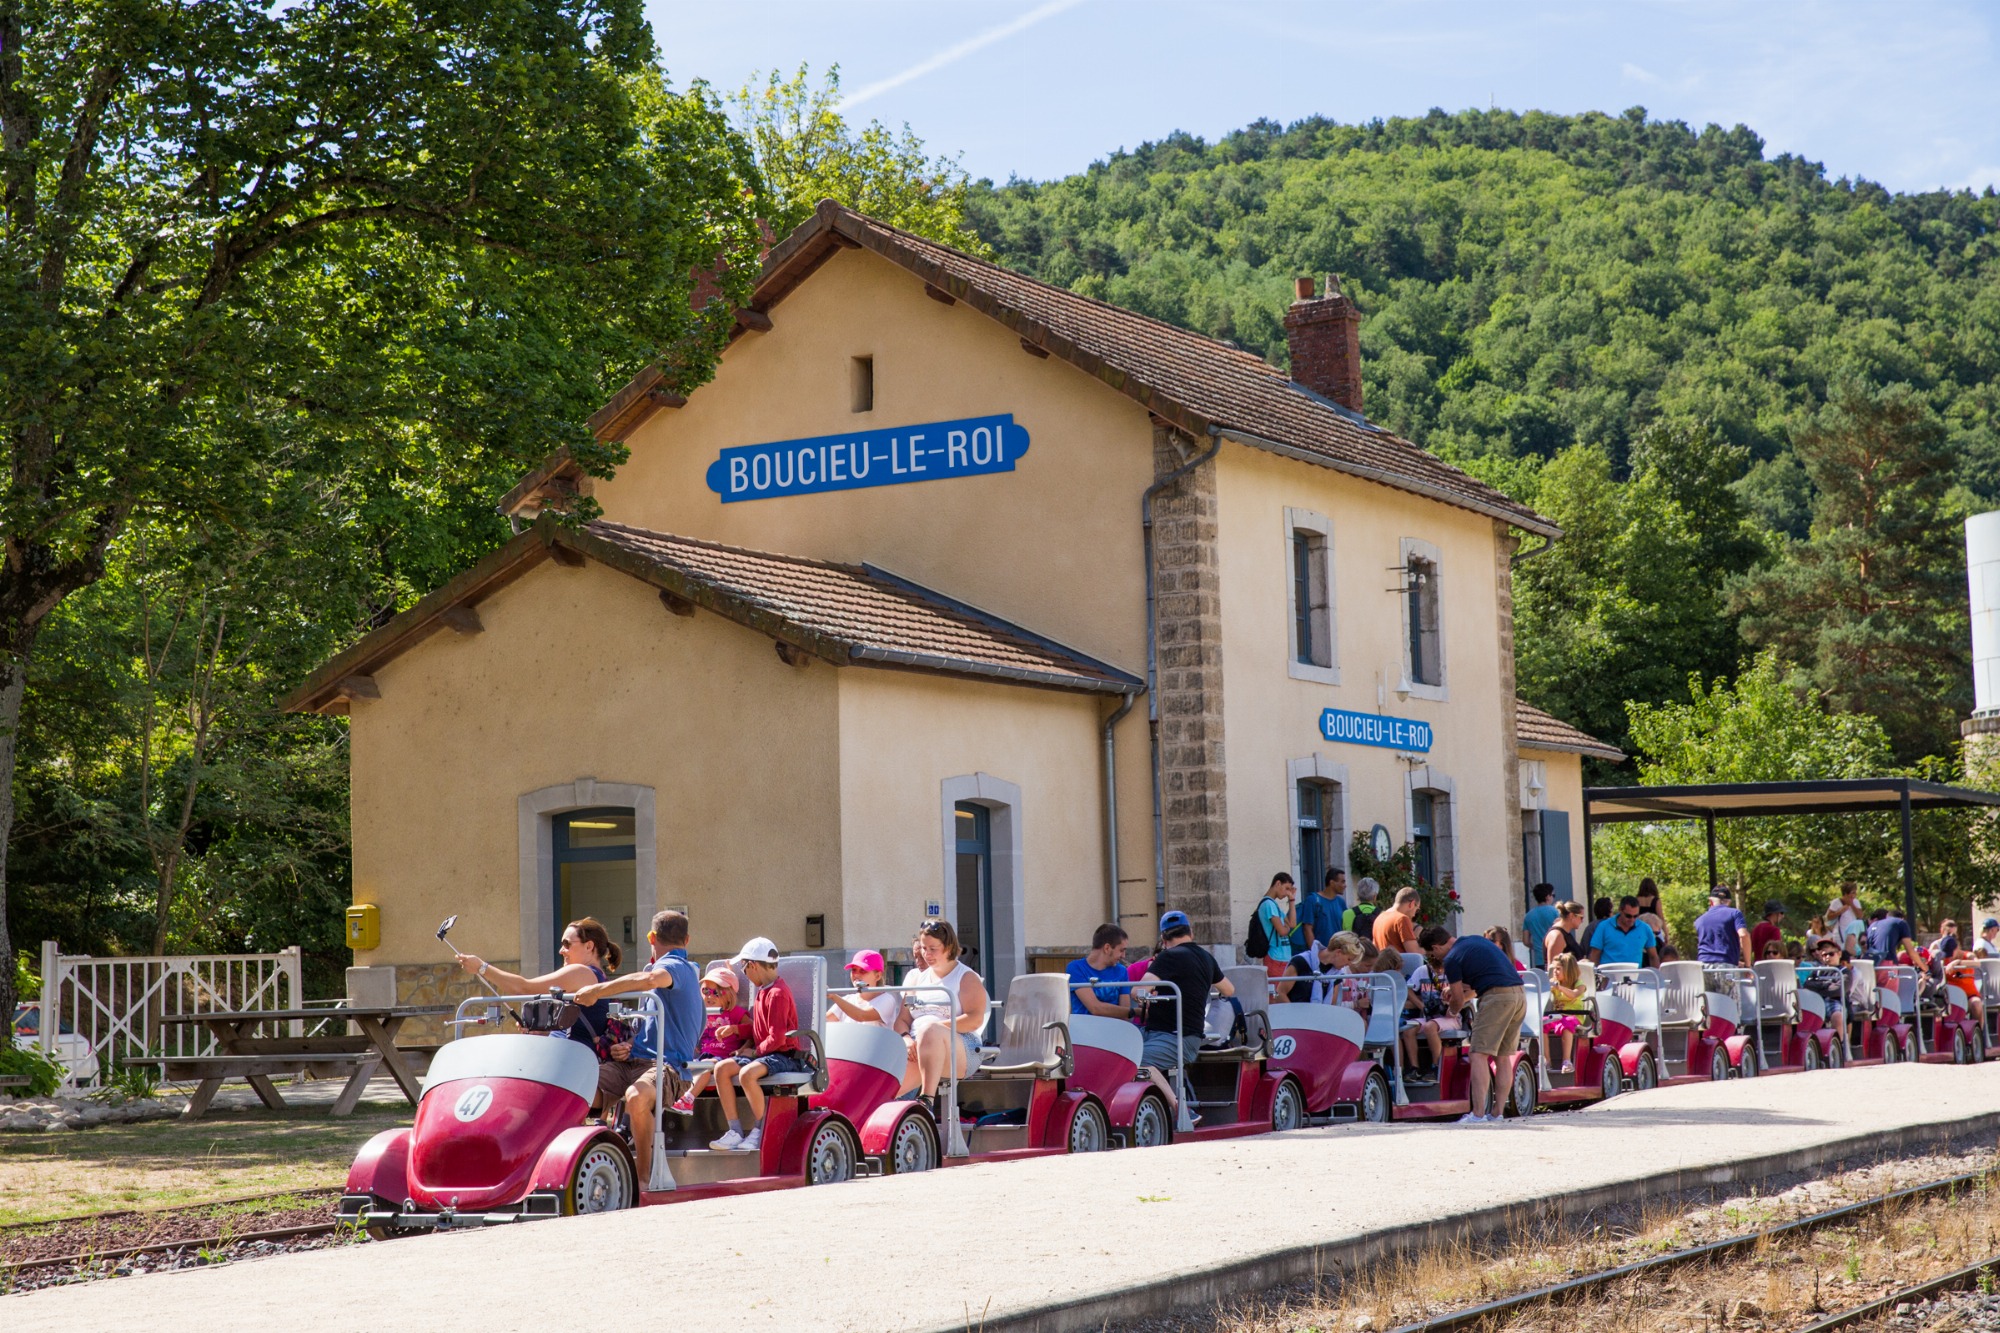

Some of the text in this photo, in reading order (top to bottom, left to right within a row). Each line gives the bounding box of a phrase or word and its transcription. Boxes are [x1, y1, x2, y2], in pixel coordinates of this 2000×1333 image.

[730, 425, 1003, 493] BOUCIEU-LE-ROI
[1326, 713, 1428, 748] BOUCIEU-LE-ROI
[1274, 1038, 1293, 1056] 48
[458, 1091, 490, 1116] 47
